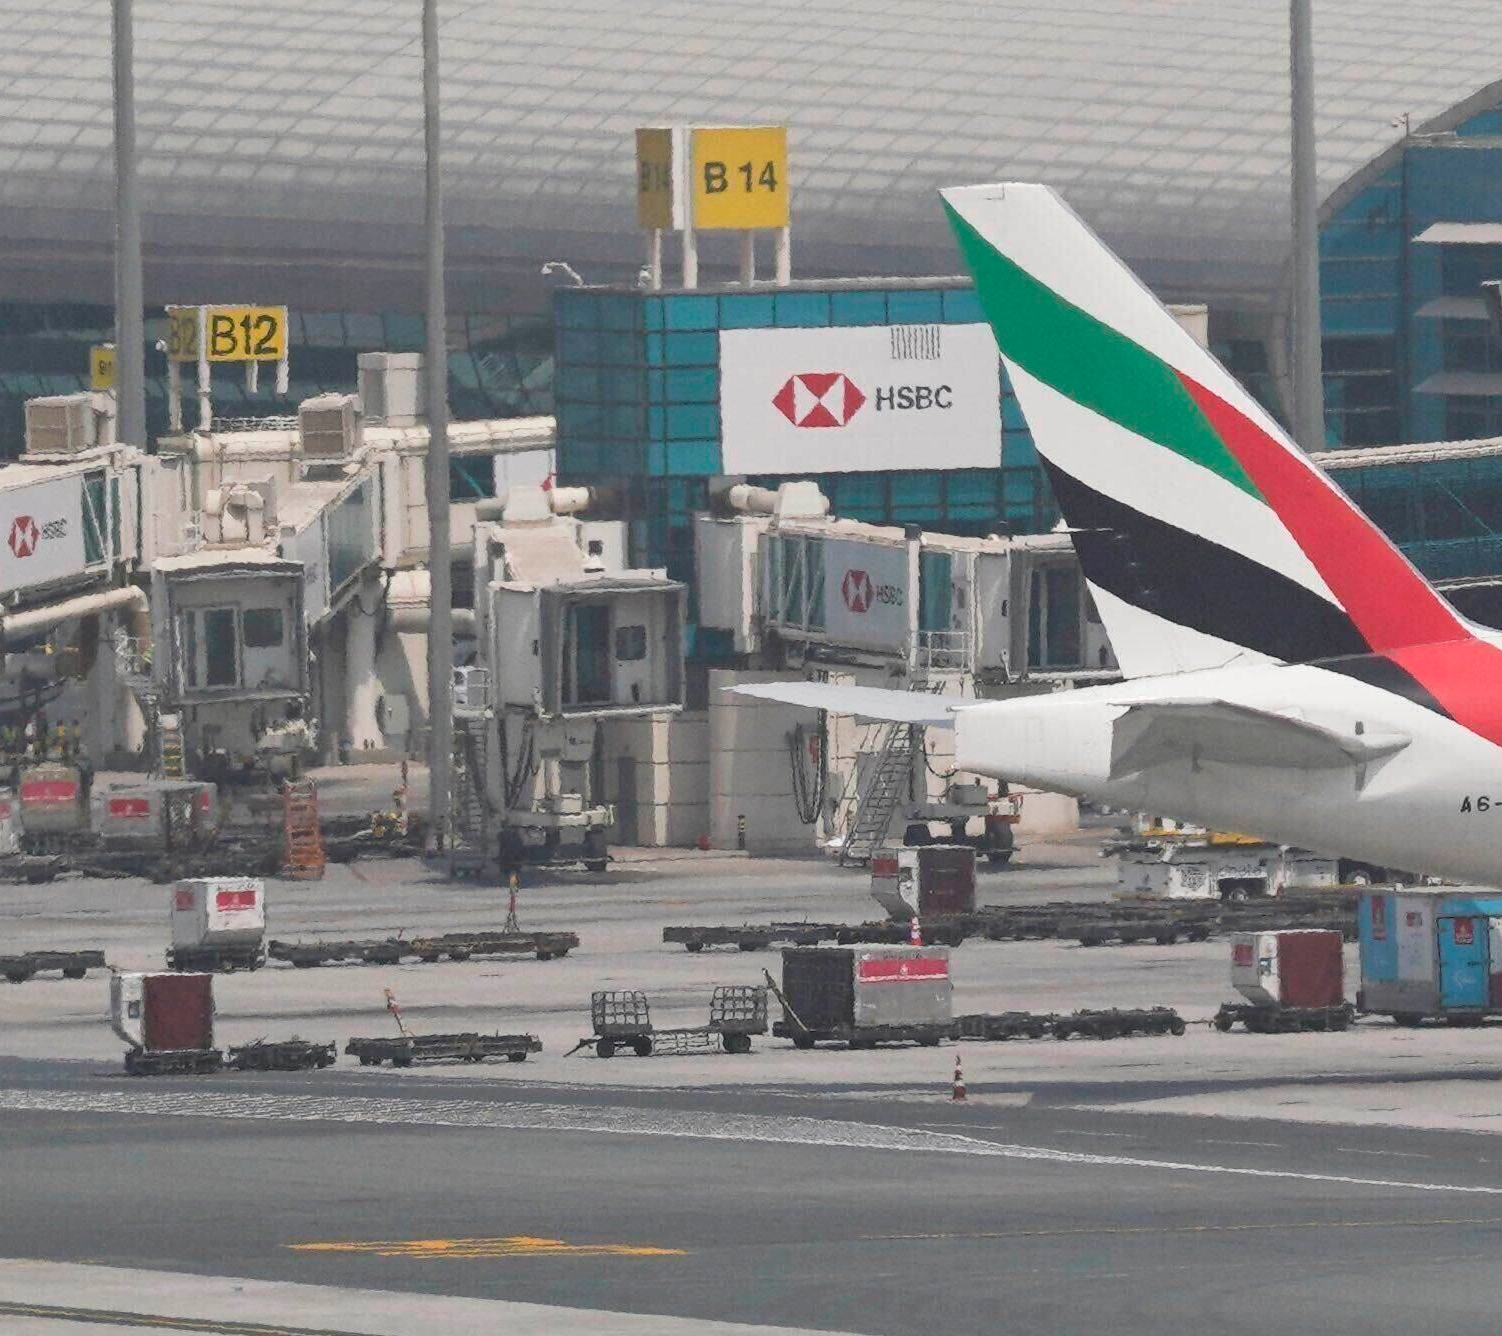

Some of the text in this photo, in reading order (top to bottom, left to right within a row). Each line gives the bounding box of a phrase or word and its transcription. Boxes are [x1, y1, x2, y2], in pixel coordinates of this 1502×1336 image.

[704, 160, 778, 194] B 14
[211, 314, 278, 356] B12
[875, 385, 953, 411] HSBC
